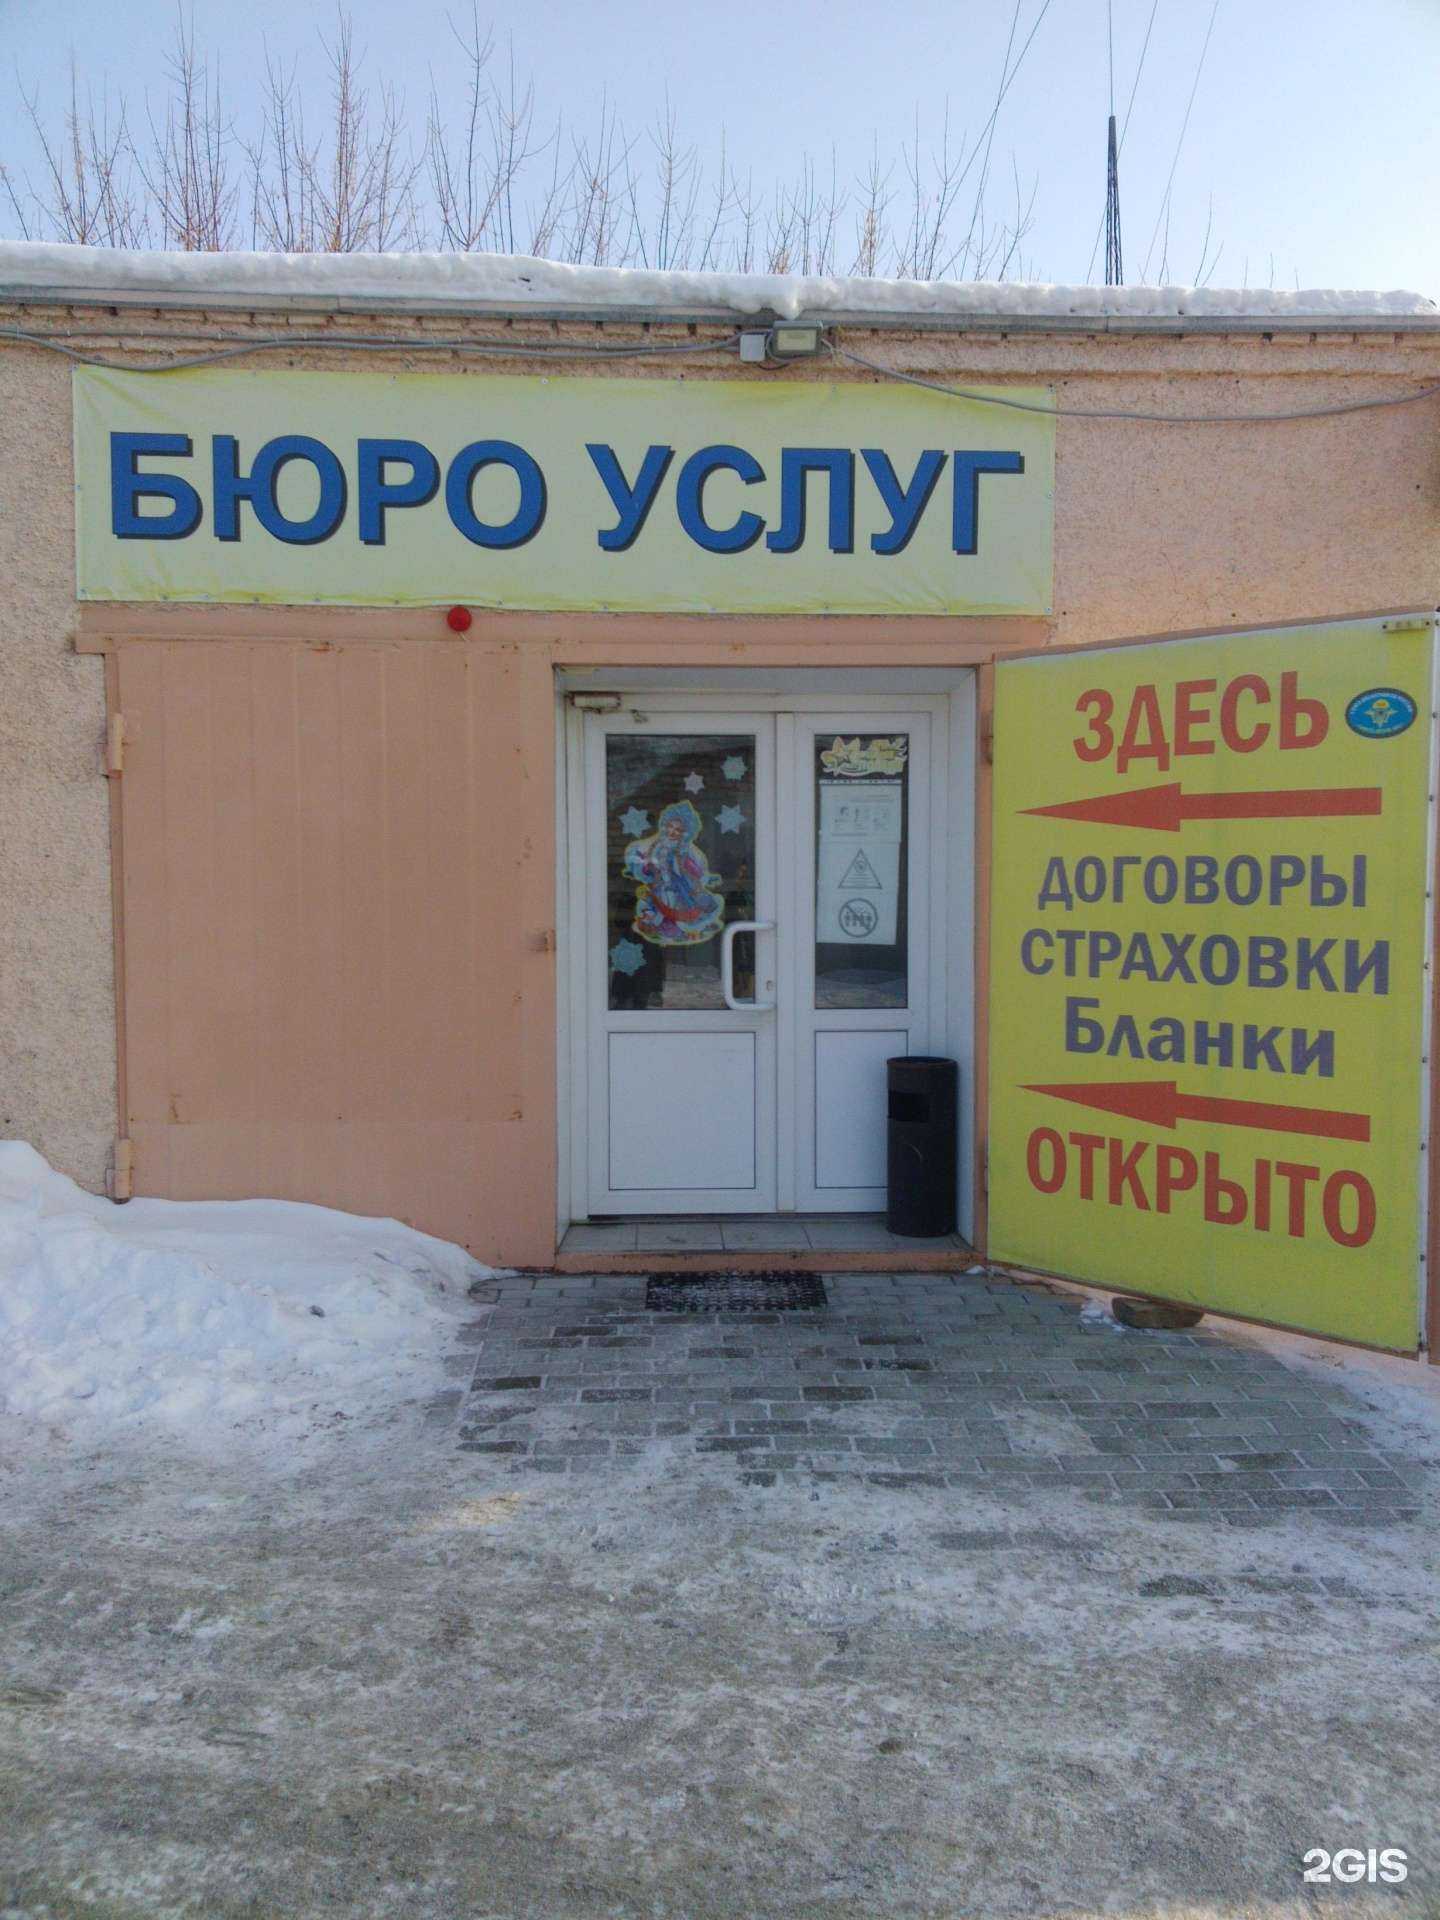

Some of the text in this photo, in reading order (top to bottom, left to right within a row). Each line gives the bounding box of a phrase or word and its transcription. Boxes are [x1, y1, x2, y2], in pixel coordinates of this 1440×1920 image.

[109, 431, 1024, 555] БЮРО УСЛУГ
[1073, 671, 1329, 773] ЗДЕСЬ
[1038, 854, 1367, 911] ДОГОВОРЫ
[1021, 928, 1390, 995] СТРАХОВКИ
[1065, 997, 1335, 1078] Бланки
[1026, 1127, 1376, 1249] ОТКРЫТО
